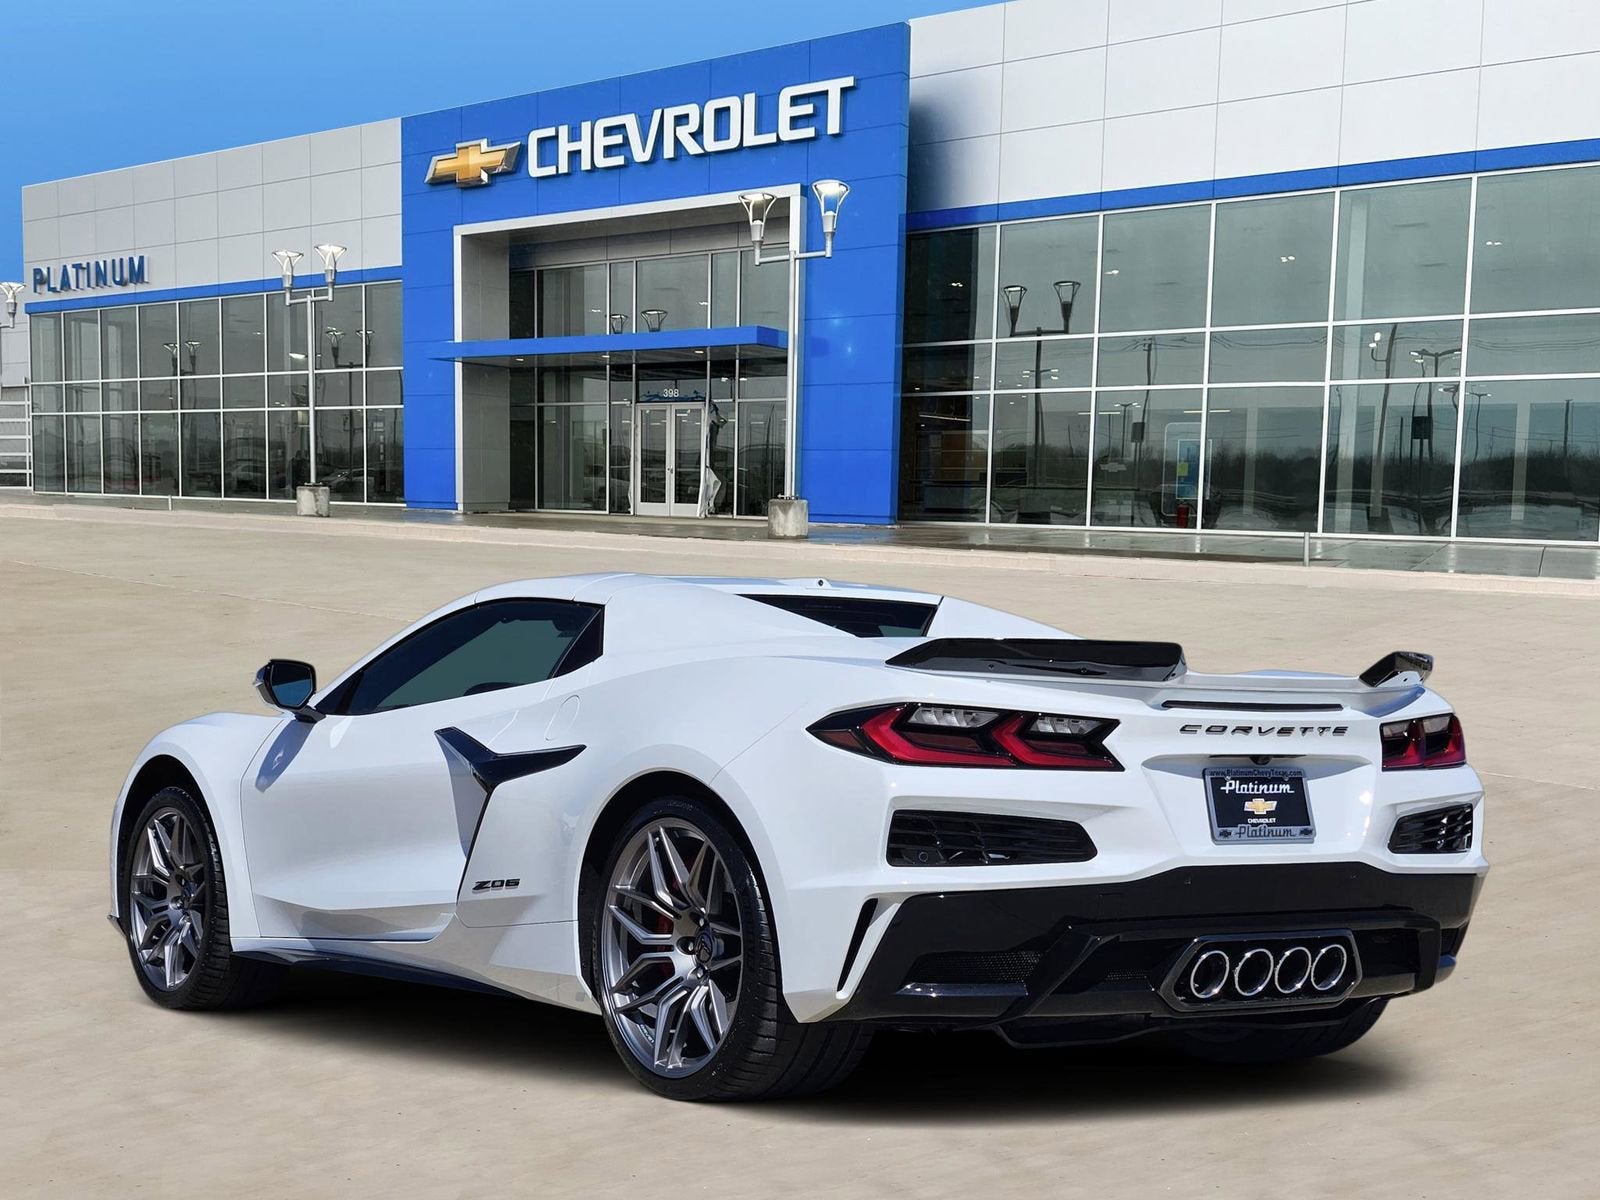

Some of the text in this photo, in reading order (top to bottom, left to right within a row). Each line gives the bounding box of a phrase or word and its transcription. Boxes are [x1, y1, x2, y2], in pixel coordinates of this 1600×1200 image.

[527, 76, 855, 178] CHEVROLET
[33, 255, 146, 293] PLATINUM
[663, 388, 679, 398] 398
[1179, 724, 1349, 737] CORVETTE
[1220, 780, 1295, 794] Platinum
[1235, 825, 1297, 838] Platinum
[472, 879, 520, 891] Z06
